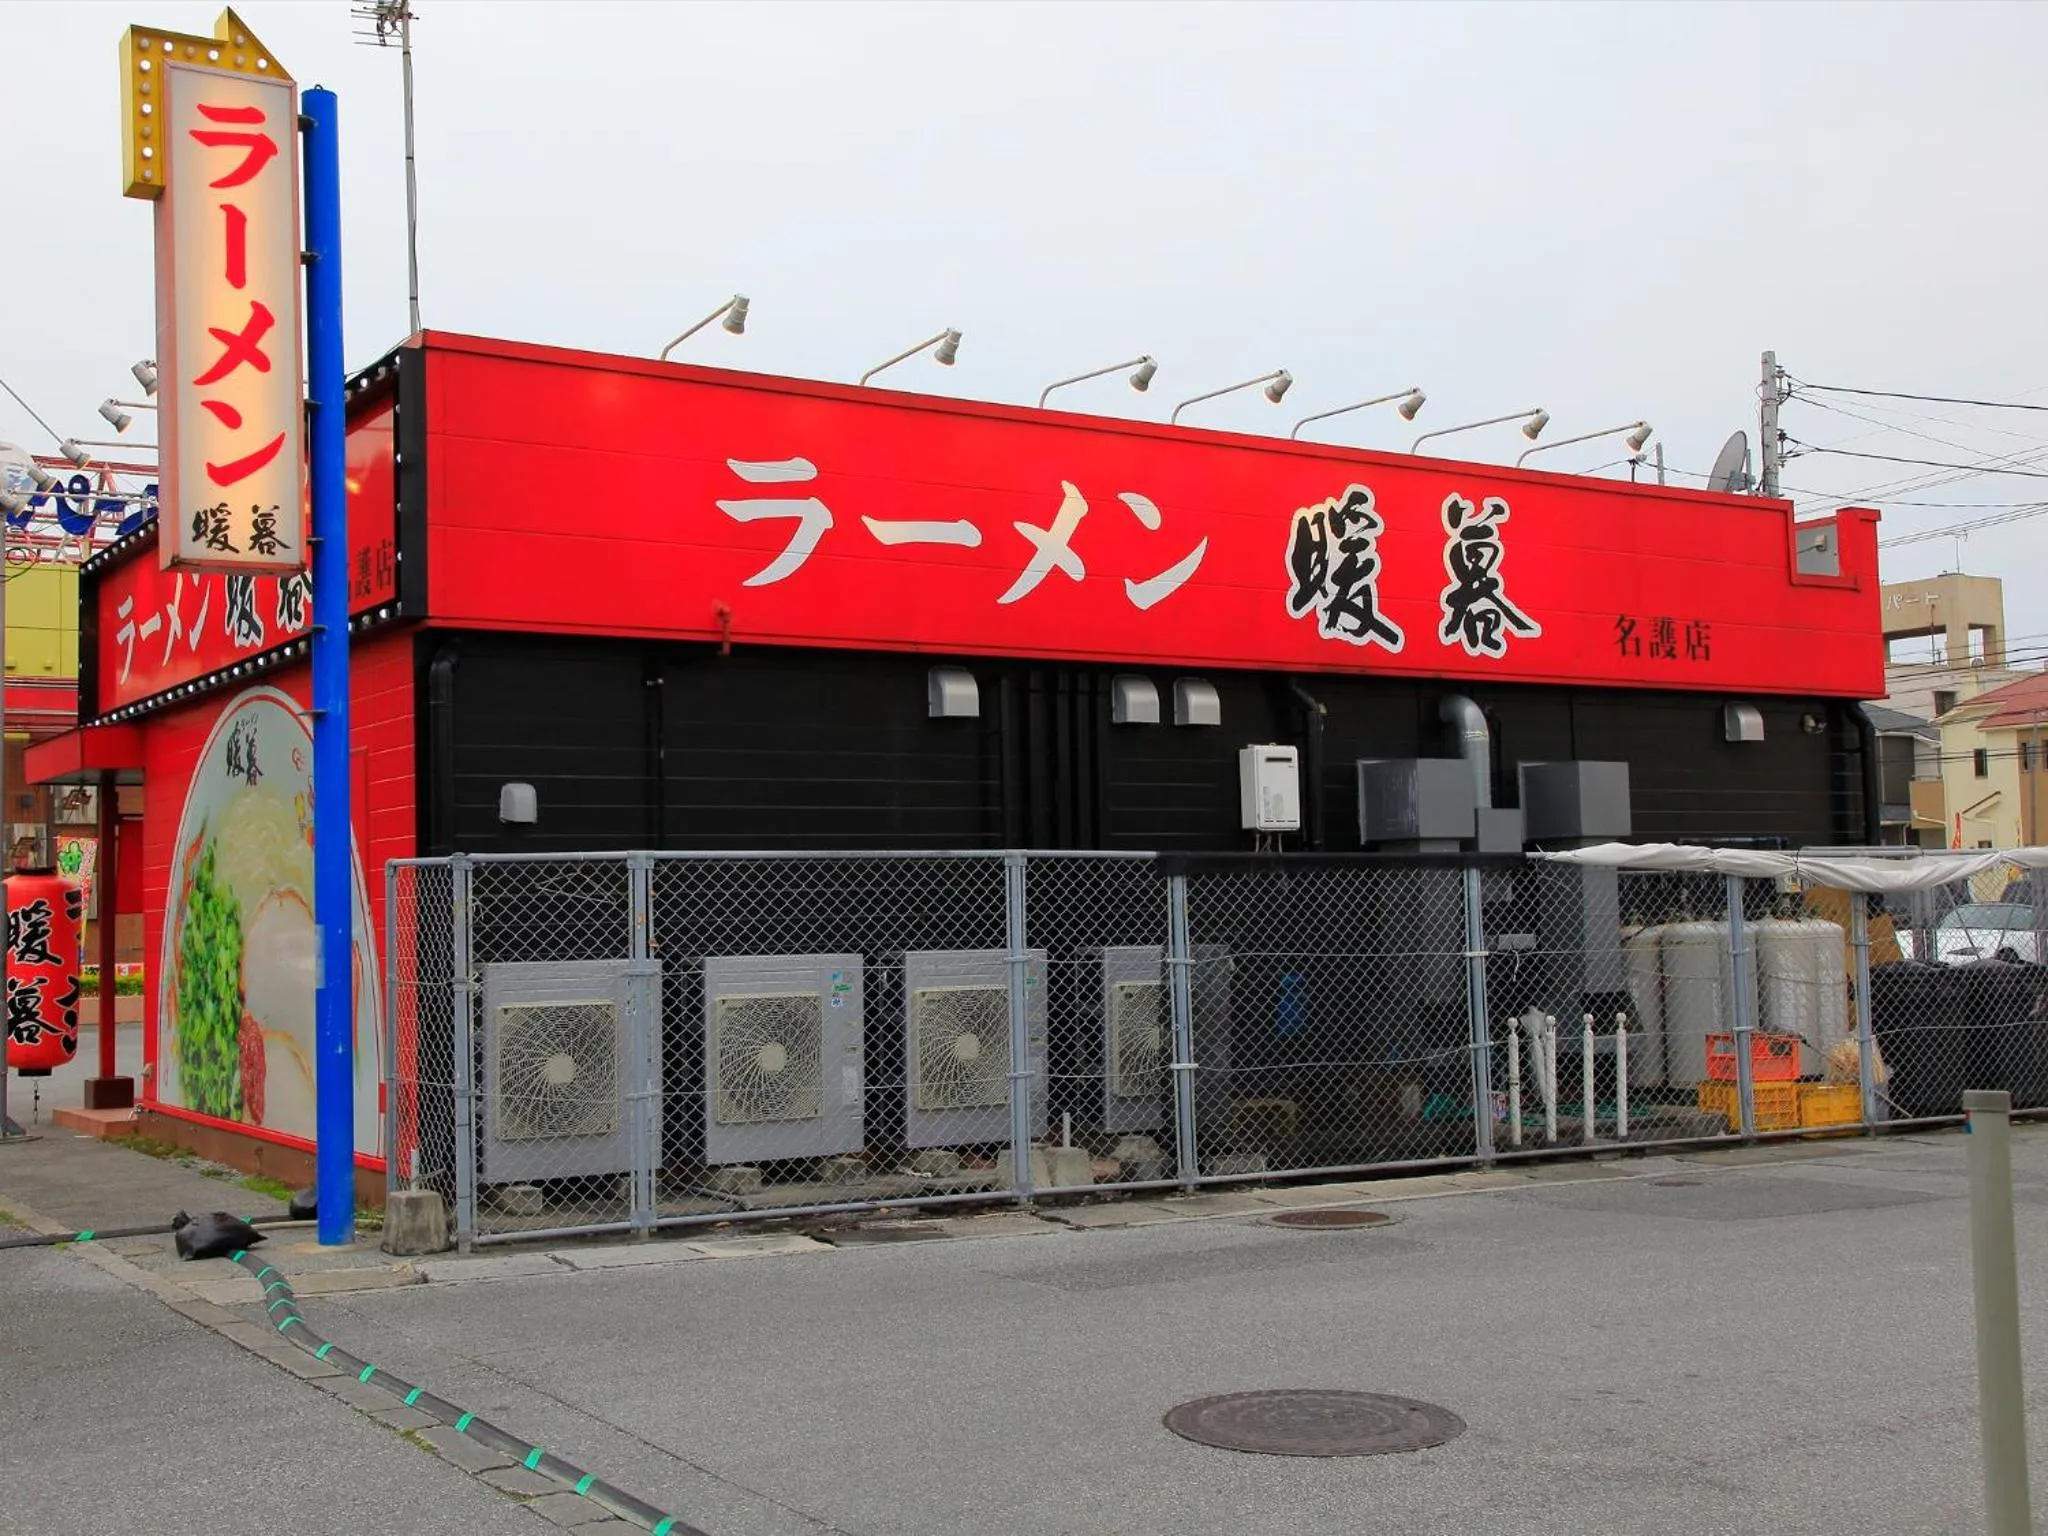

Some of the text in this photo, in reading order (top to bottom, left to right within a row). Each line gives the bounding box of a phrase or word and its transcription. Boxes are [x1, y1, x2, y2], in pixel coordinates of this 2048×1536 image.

[189, 103, 286, 487] ラーメン
[192, 502, 292, 556] 暖暮
[716, 457, 1711, 661] ラーメン 暖暮 名護店
